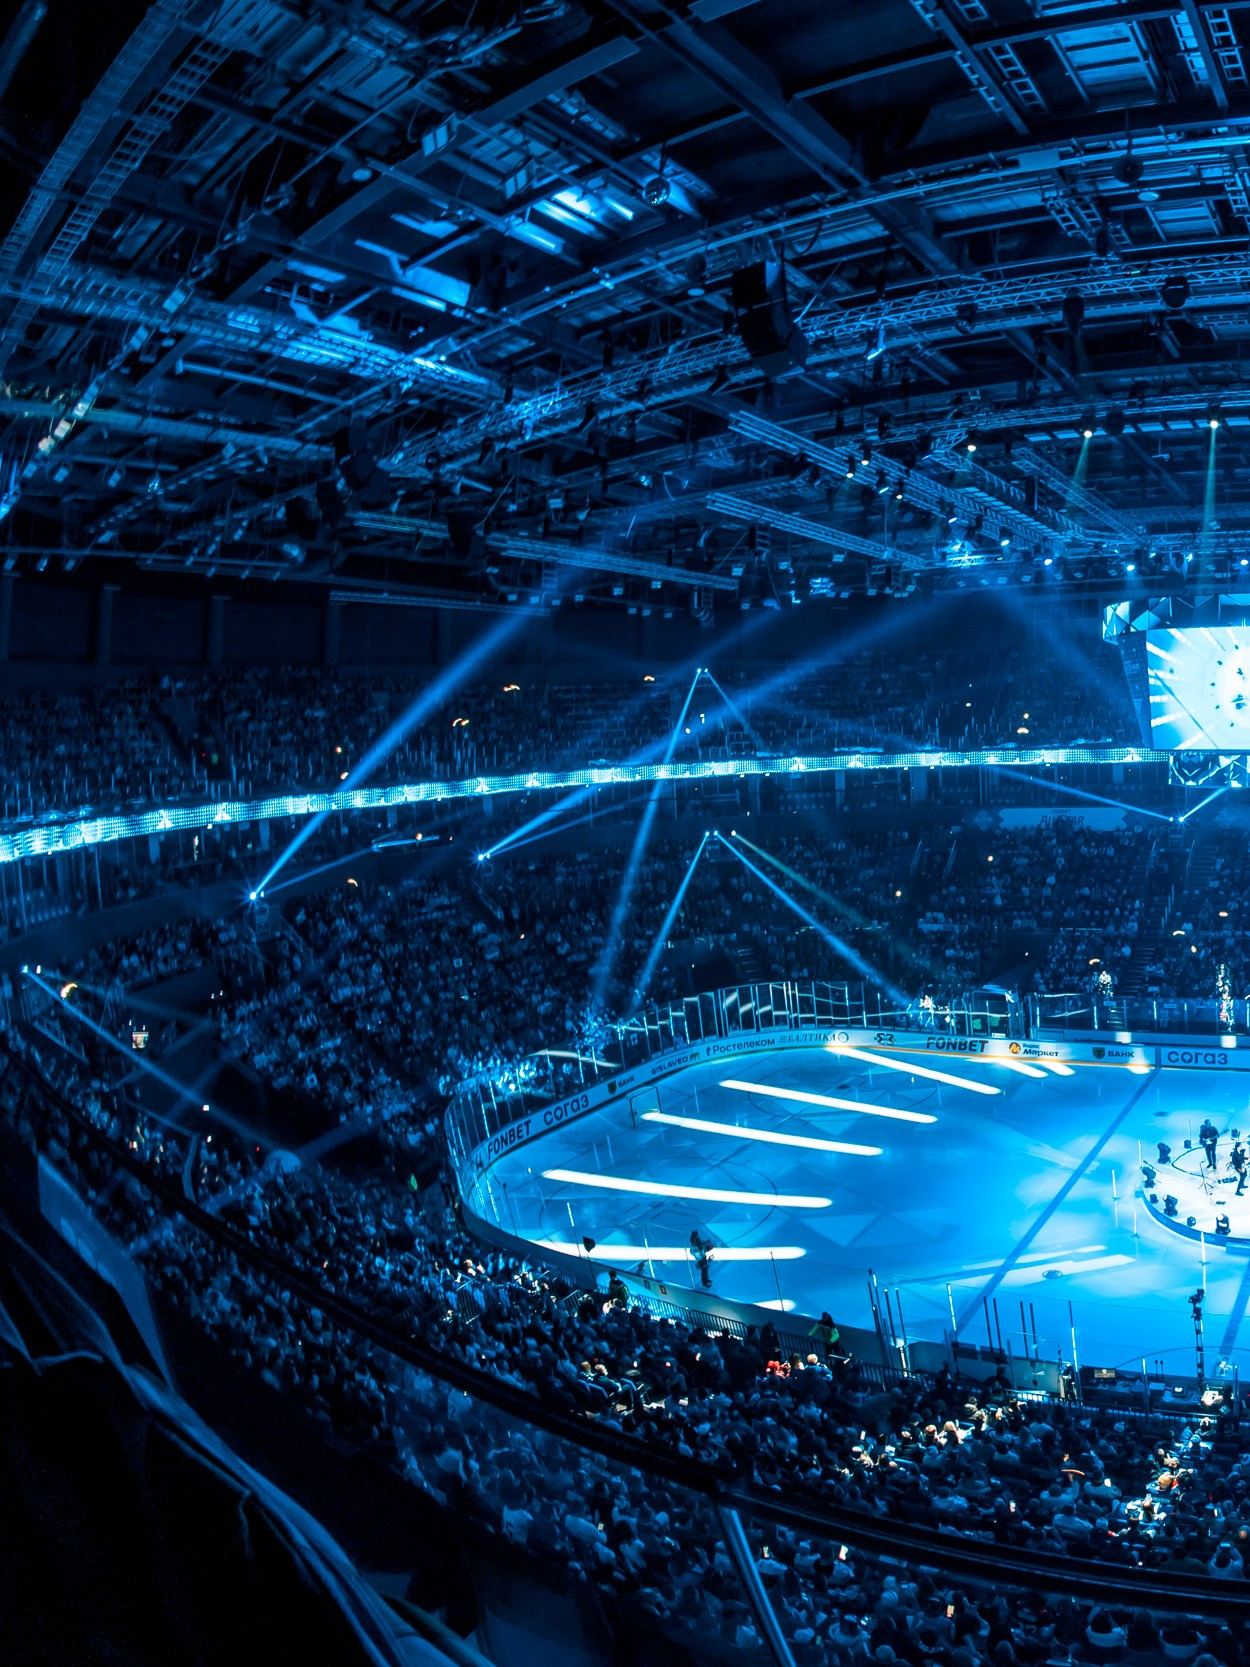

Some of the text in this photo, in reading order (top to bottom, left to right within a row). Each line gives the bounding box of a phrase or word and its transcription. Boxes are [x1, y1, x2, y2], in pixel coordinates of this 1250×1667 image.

[712, 1037, 776, 1055] Ростелеком
[926, 1036, 989, 1053] FONBET
[1022, 1048, 1060, 1057] Маркет
[1108, 1050, 1135, 1058] БАНК
[651, 1055, 689, 1076] GISLAVED
[487, 1119, 532, 1161] FONBET
